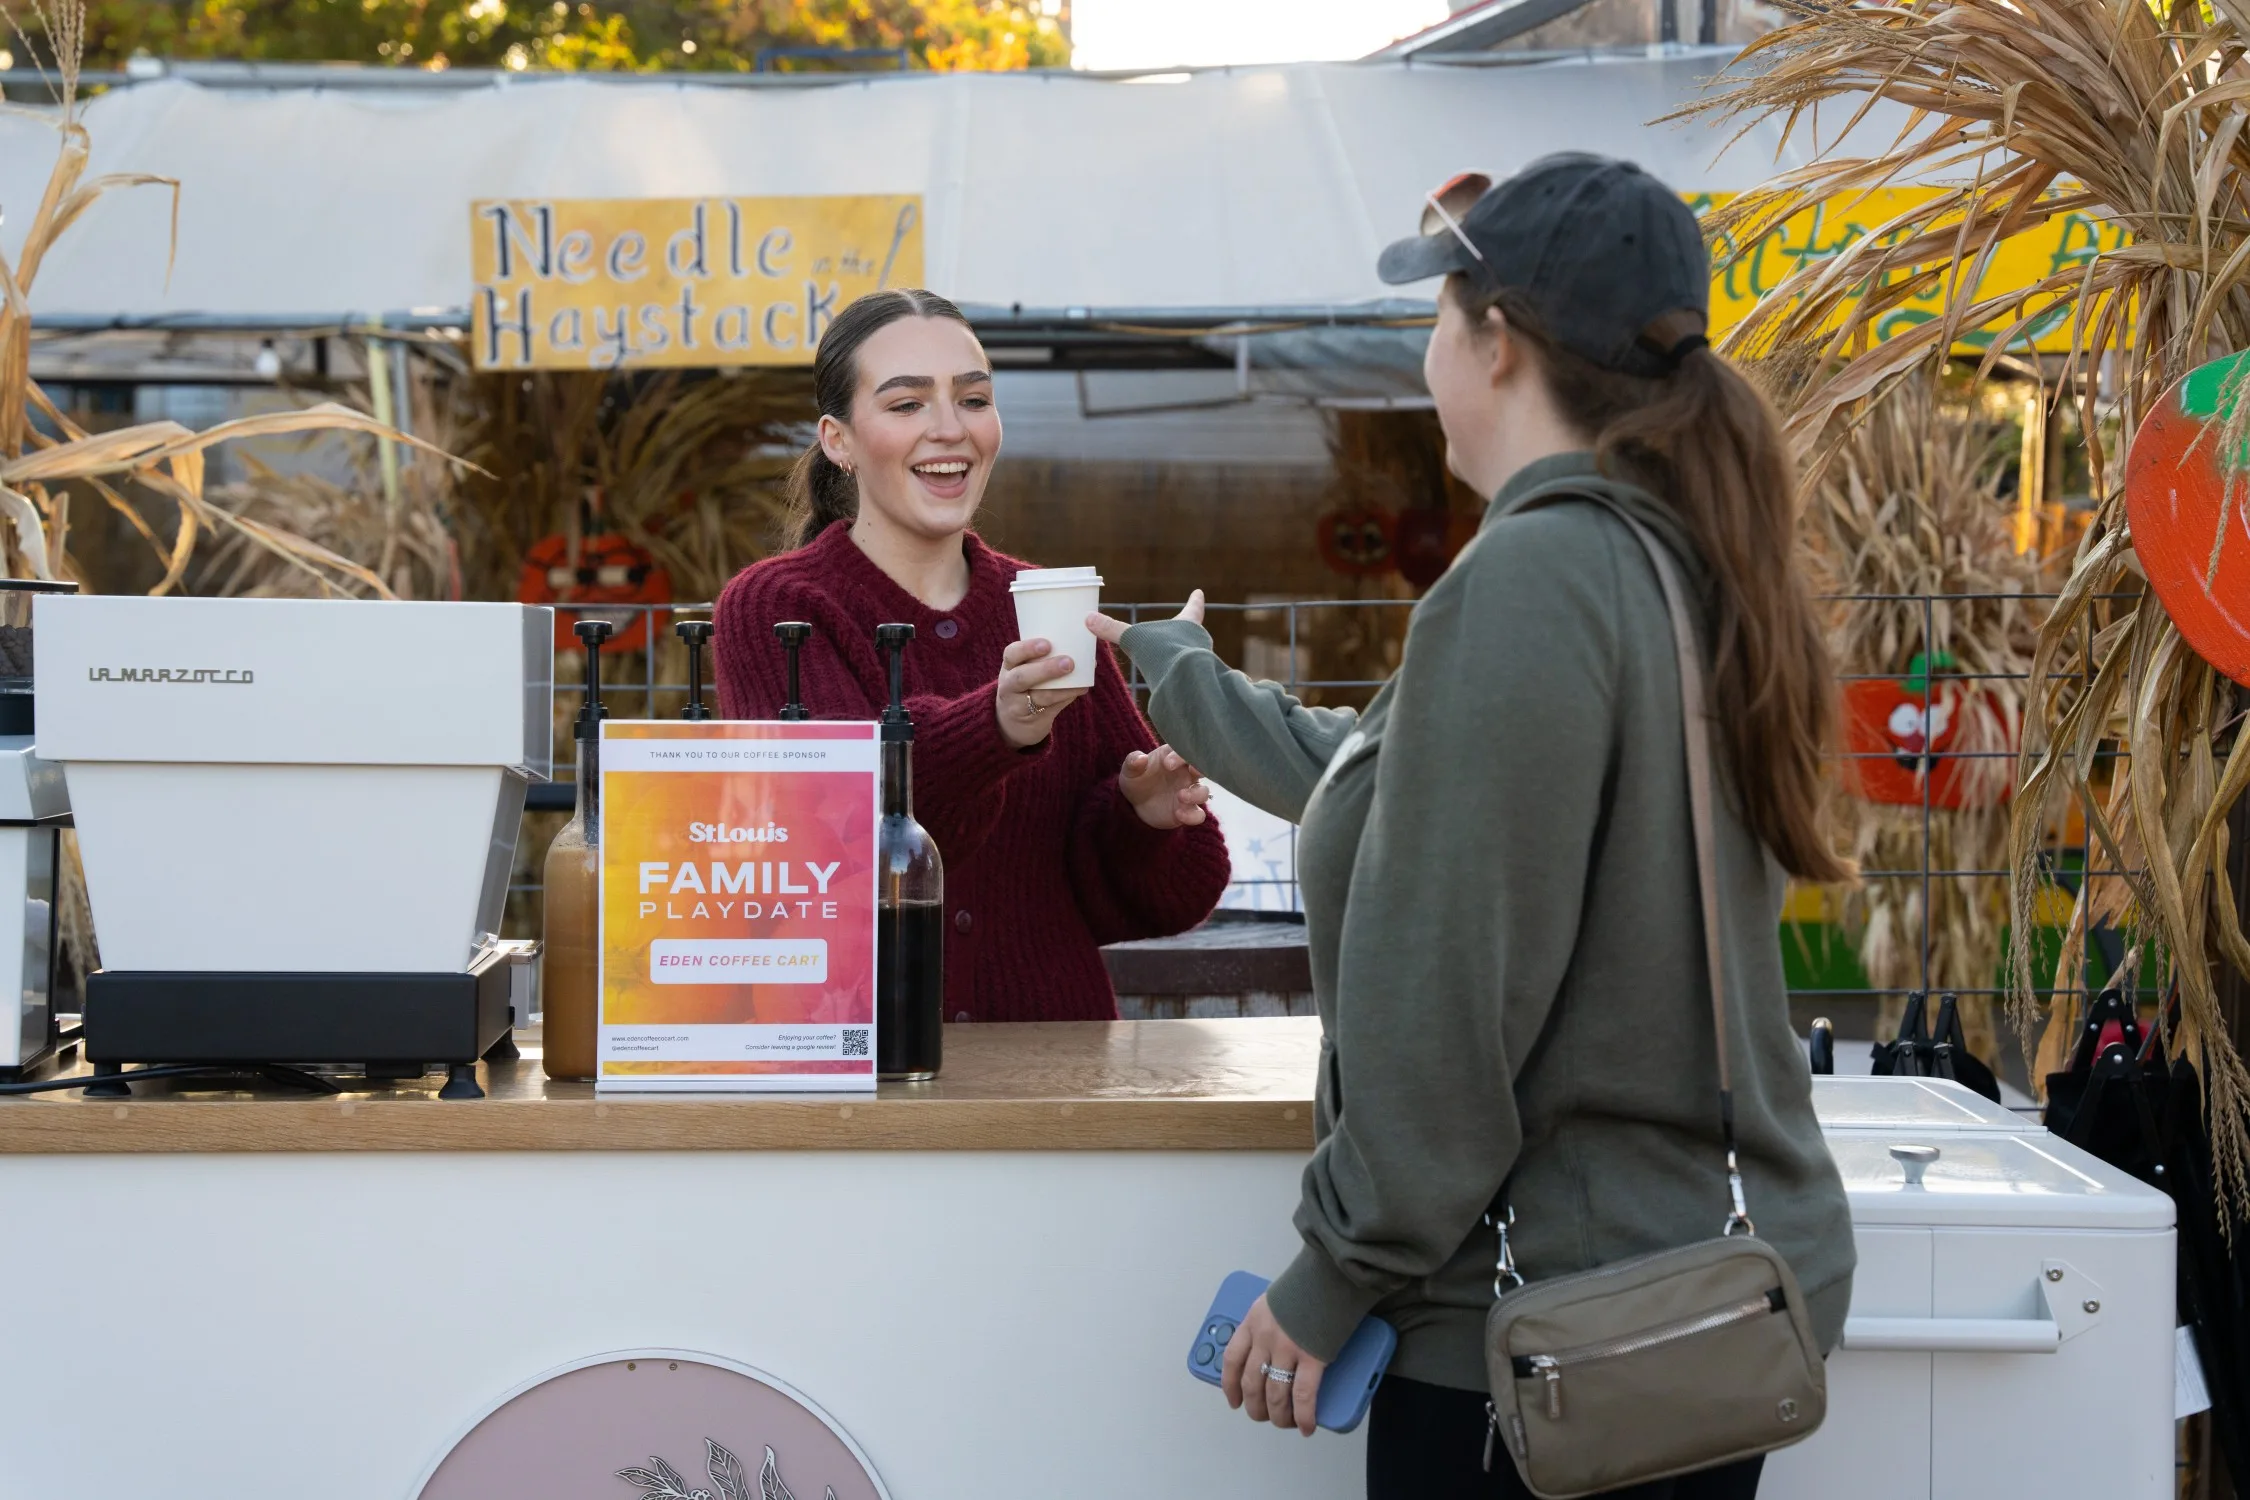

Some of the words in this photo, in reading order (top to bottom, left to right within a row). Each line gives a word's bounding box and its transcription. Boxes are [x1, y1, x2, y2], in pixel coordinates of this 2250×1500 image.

[480, 198, 795, 283] Needle
[474, 280, 840, 370] Haystack
[89, 667, 110, 682] LA
[121, 667, 254, 684] MARZOCCO
[650, 751, 682, 759] THANK
[685, 751, 703, 759] YOU
[707, 751, 718, 759] TO
[721, 751, 740, 759] OUR
[743, 751, 780, 759] COFFEE
[782, 751, 827, 759] SPONSOR
[639, 861, 841, 894] FAMILY
[639, 901, 838, 919] PLAYDATE
[659, 955, 703, 966] EDEN
[709, 955, 772, 966] COFFEE
[777, 954, 820, 966] CART
[778, 1034, 802, 1042] Enjoying
[796, 1044, 816, 1052] google
